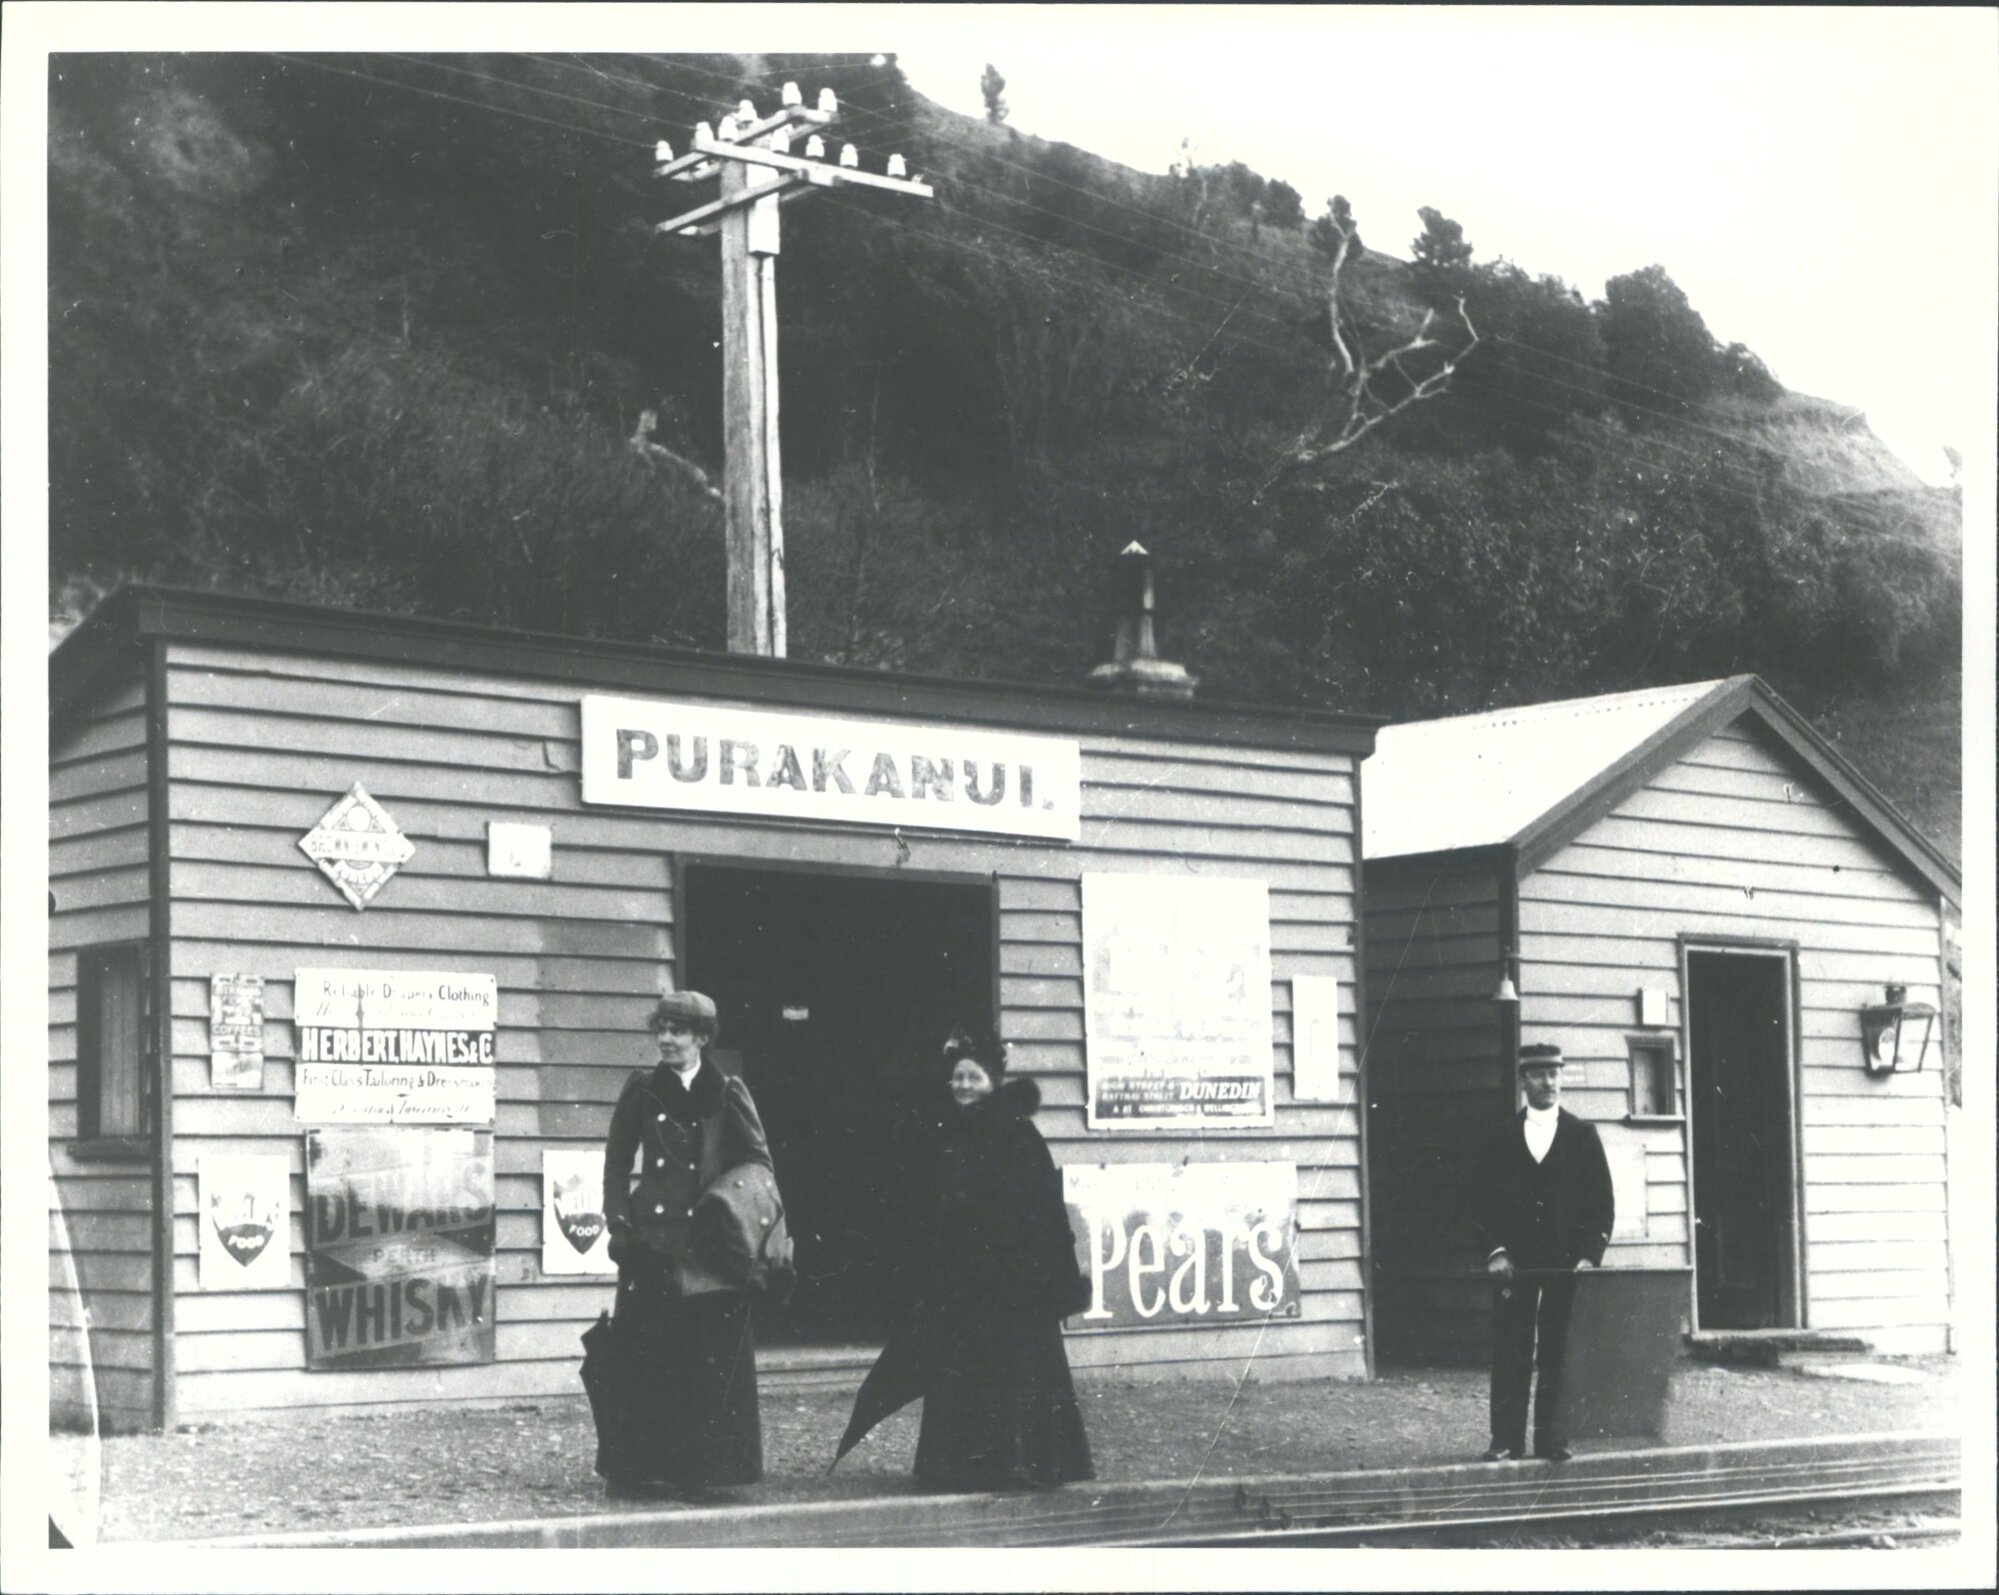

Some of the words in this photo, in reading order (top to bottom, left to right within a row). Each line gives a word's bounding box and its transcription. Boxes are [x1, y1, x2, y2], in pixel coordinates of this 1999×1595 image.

[438, 984, 490, 1006] Clothing
[303, 1068, 329, 1087] Firt
[331, 1069, 363, 1087] Clas
[1179, 1081, 1262, 1100] DUNEDIN
[569, 1224, 600, 1236] FOOD
[228, 1234, 265, 1249] FOOD
[1080, 1204, 1284, 1321] Pears
[315, 1273, 489, 1351] WHISKY
